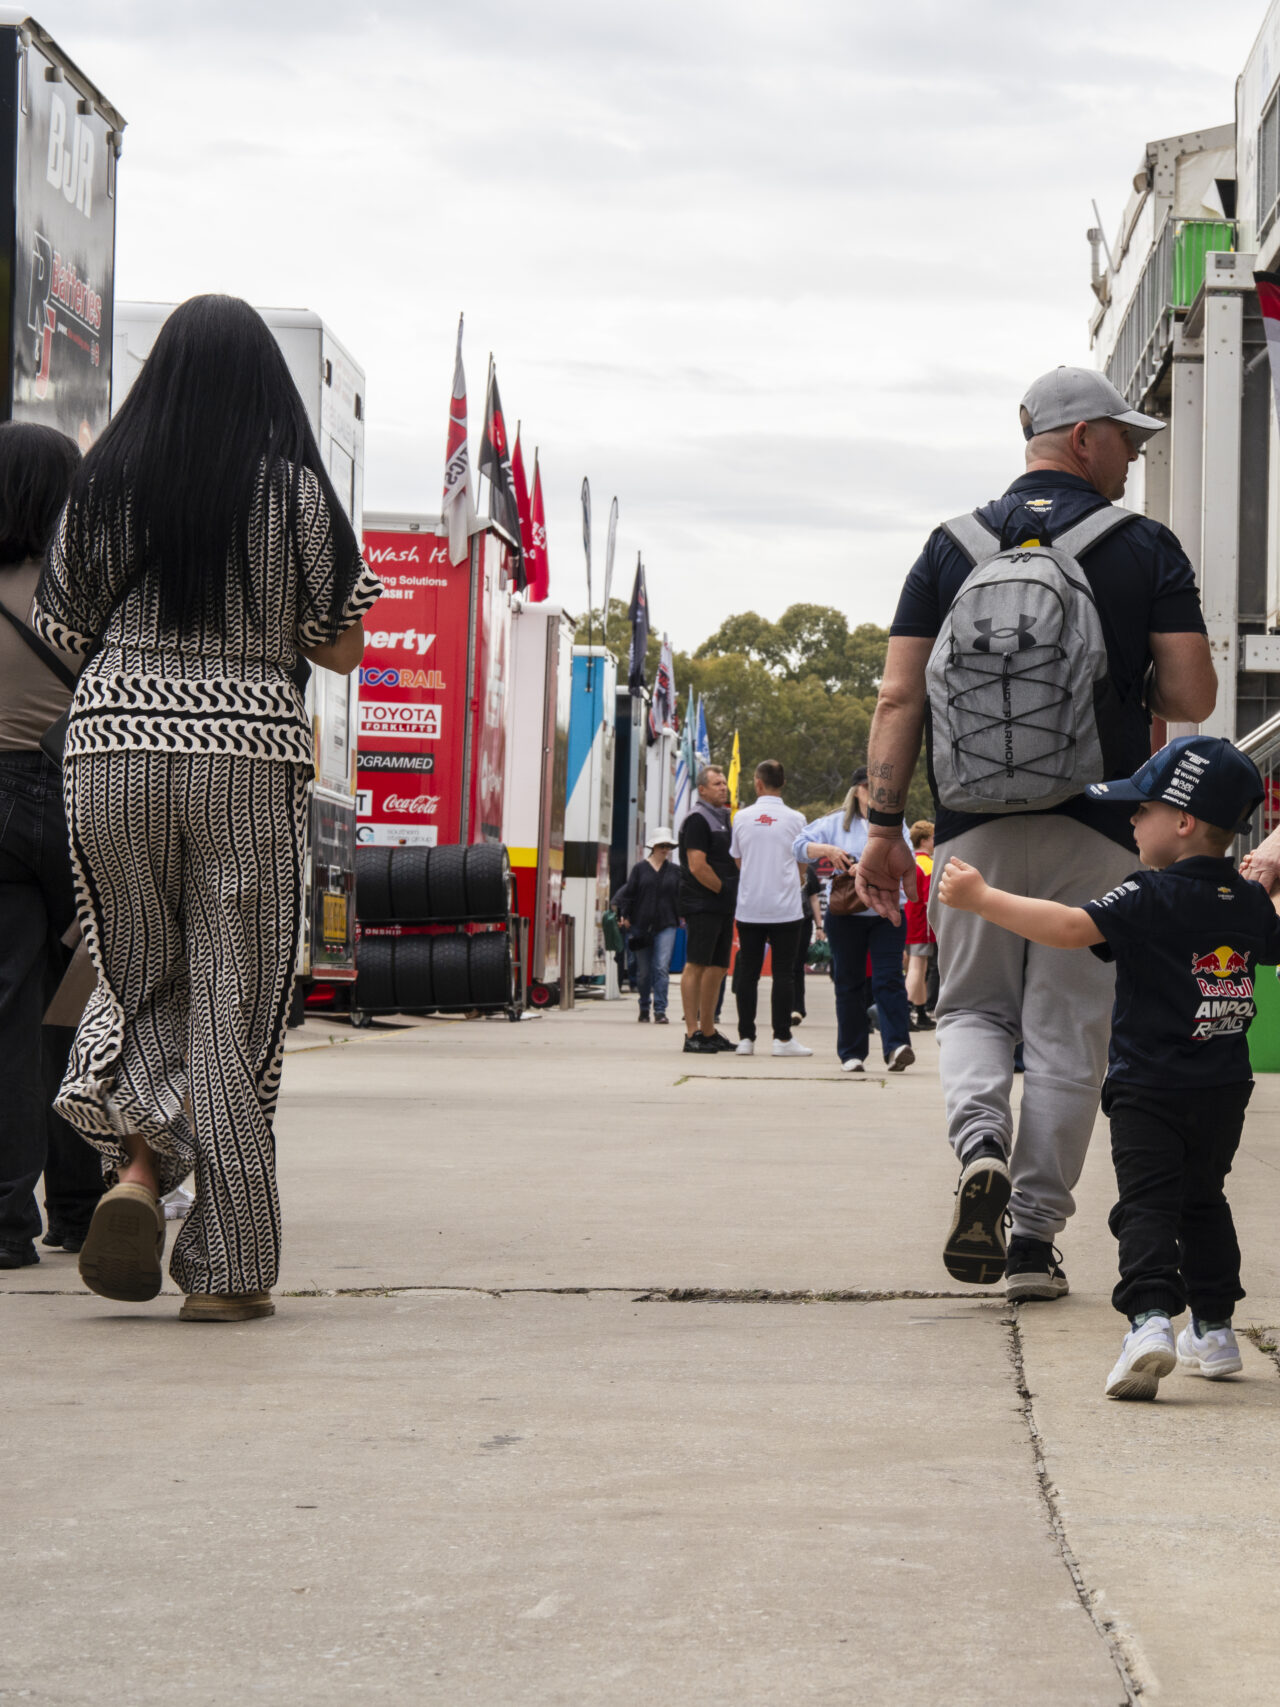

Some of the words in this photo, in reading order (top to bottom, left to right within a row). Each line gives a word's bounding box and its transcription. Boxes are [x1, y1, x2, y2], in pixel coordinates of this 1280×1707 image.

[46, 92, 95, 219] BJR
[51, 250, 102, 330] Batteries
[368, 545, 420, 564] Wash
[428, 546, 448, 564] It
[398, 576, 448, 587] Solutions
[362, 706, 437, 723] TOYOTA
[365, 722, 433, 733] FORKLIFTS
[382, 793, 440, 815] Coca-Cola
[1194, 1000, 1255, 1018] AMPOL
